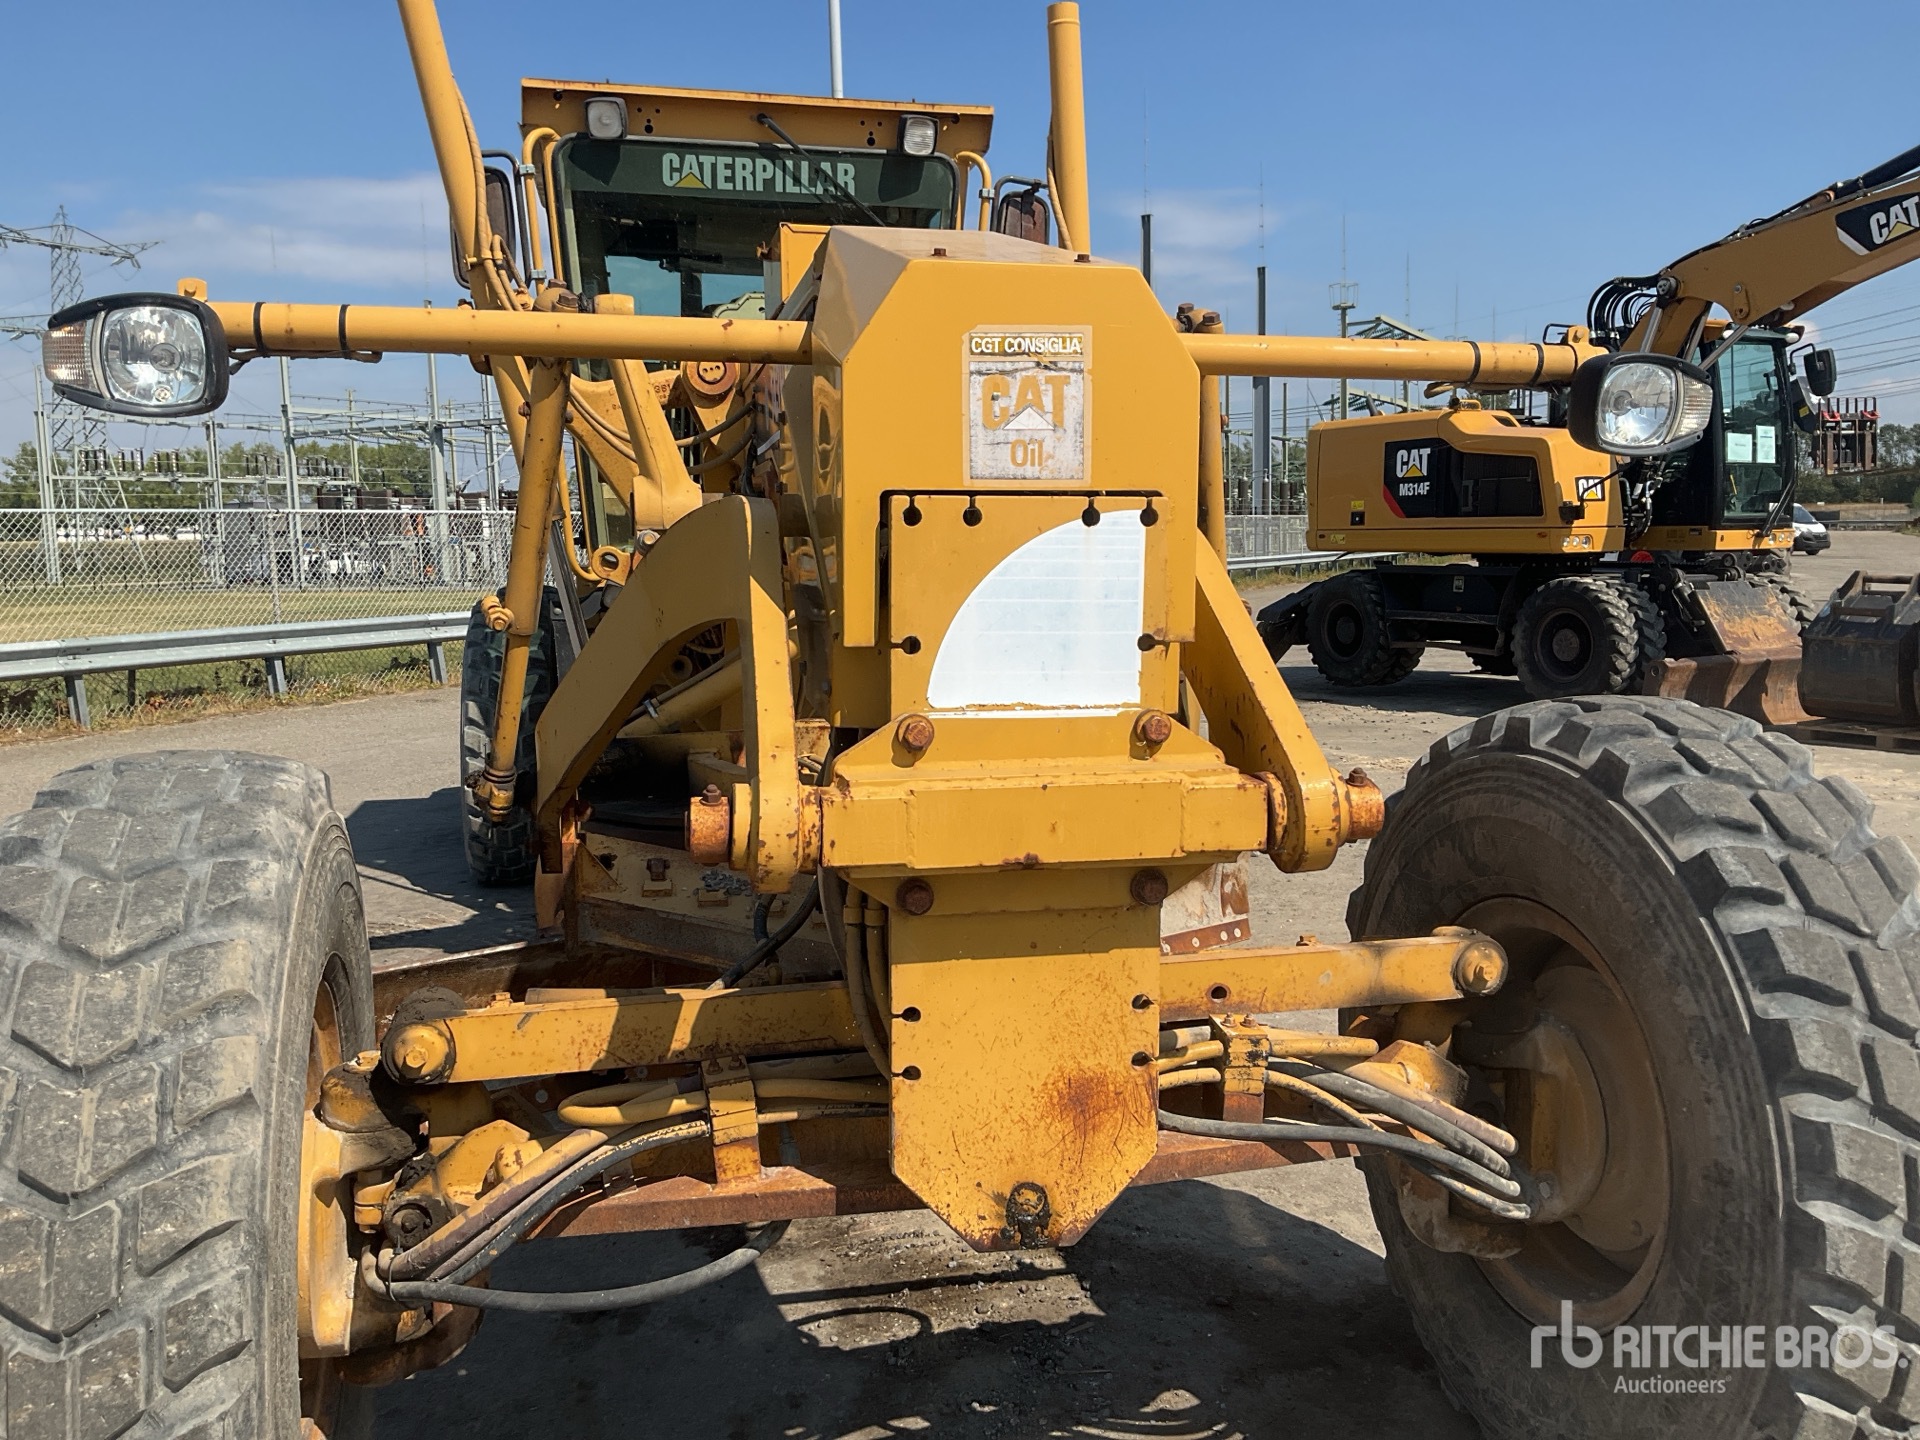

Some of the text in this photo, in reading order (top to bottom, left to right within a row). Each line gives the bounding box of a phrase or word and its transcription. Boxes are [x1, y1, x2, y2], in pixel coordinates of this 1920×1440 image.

[662, 152, 855, 196] CATERPILLAR
[1870, 195, 1920, 245] CAT
[971, 337, 1082, 353] CGT CONSIGLIA
[981, 374, 1071, 431] CAT
[1010, 438, 1045, 468] Oil
[1396, 448, 1431, 478] CAT
[1399, 482, 1430, 497] M314F
